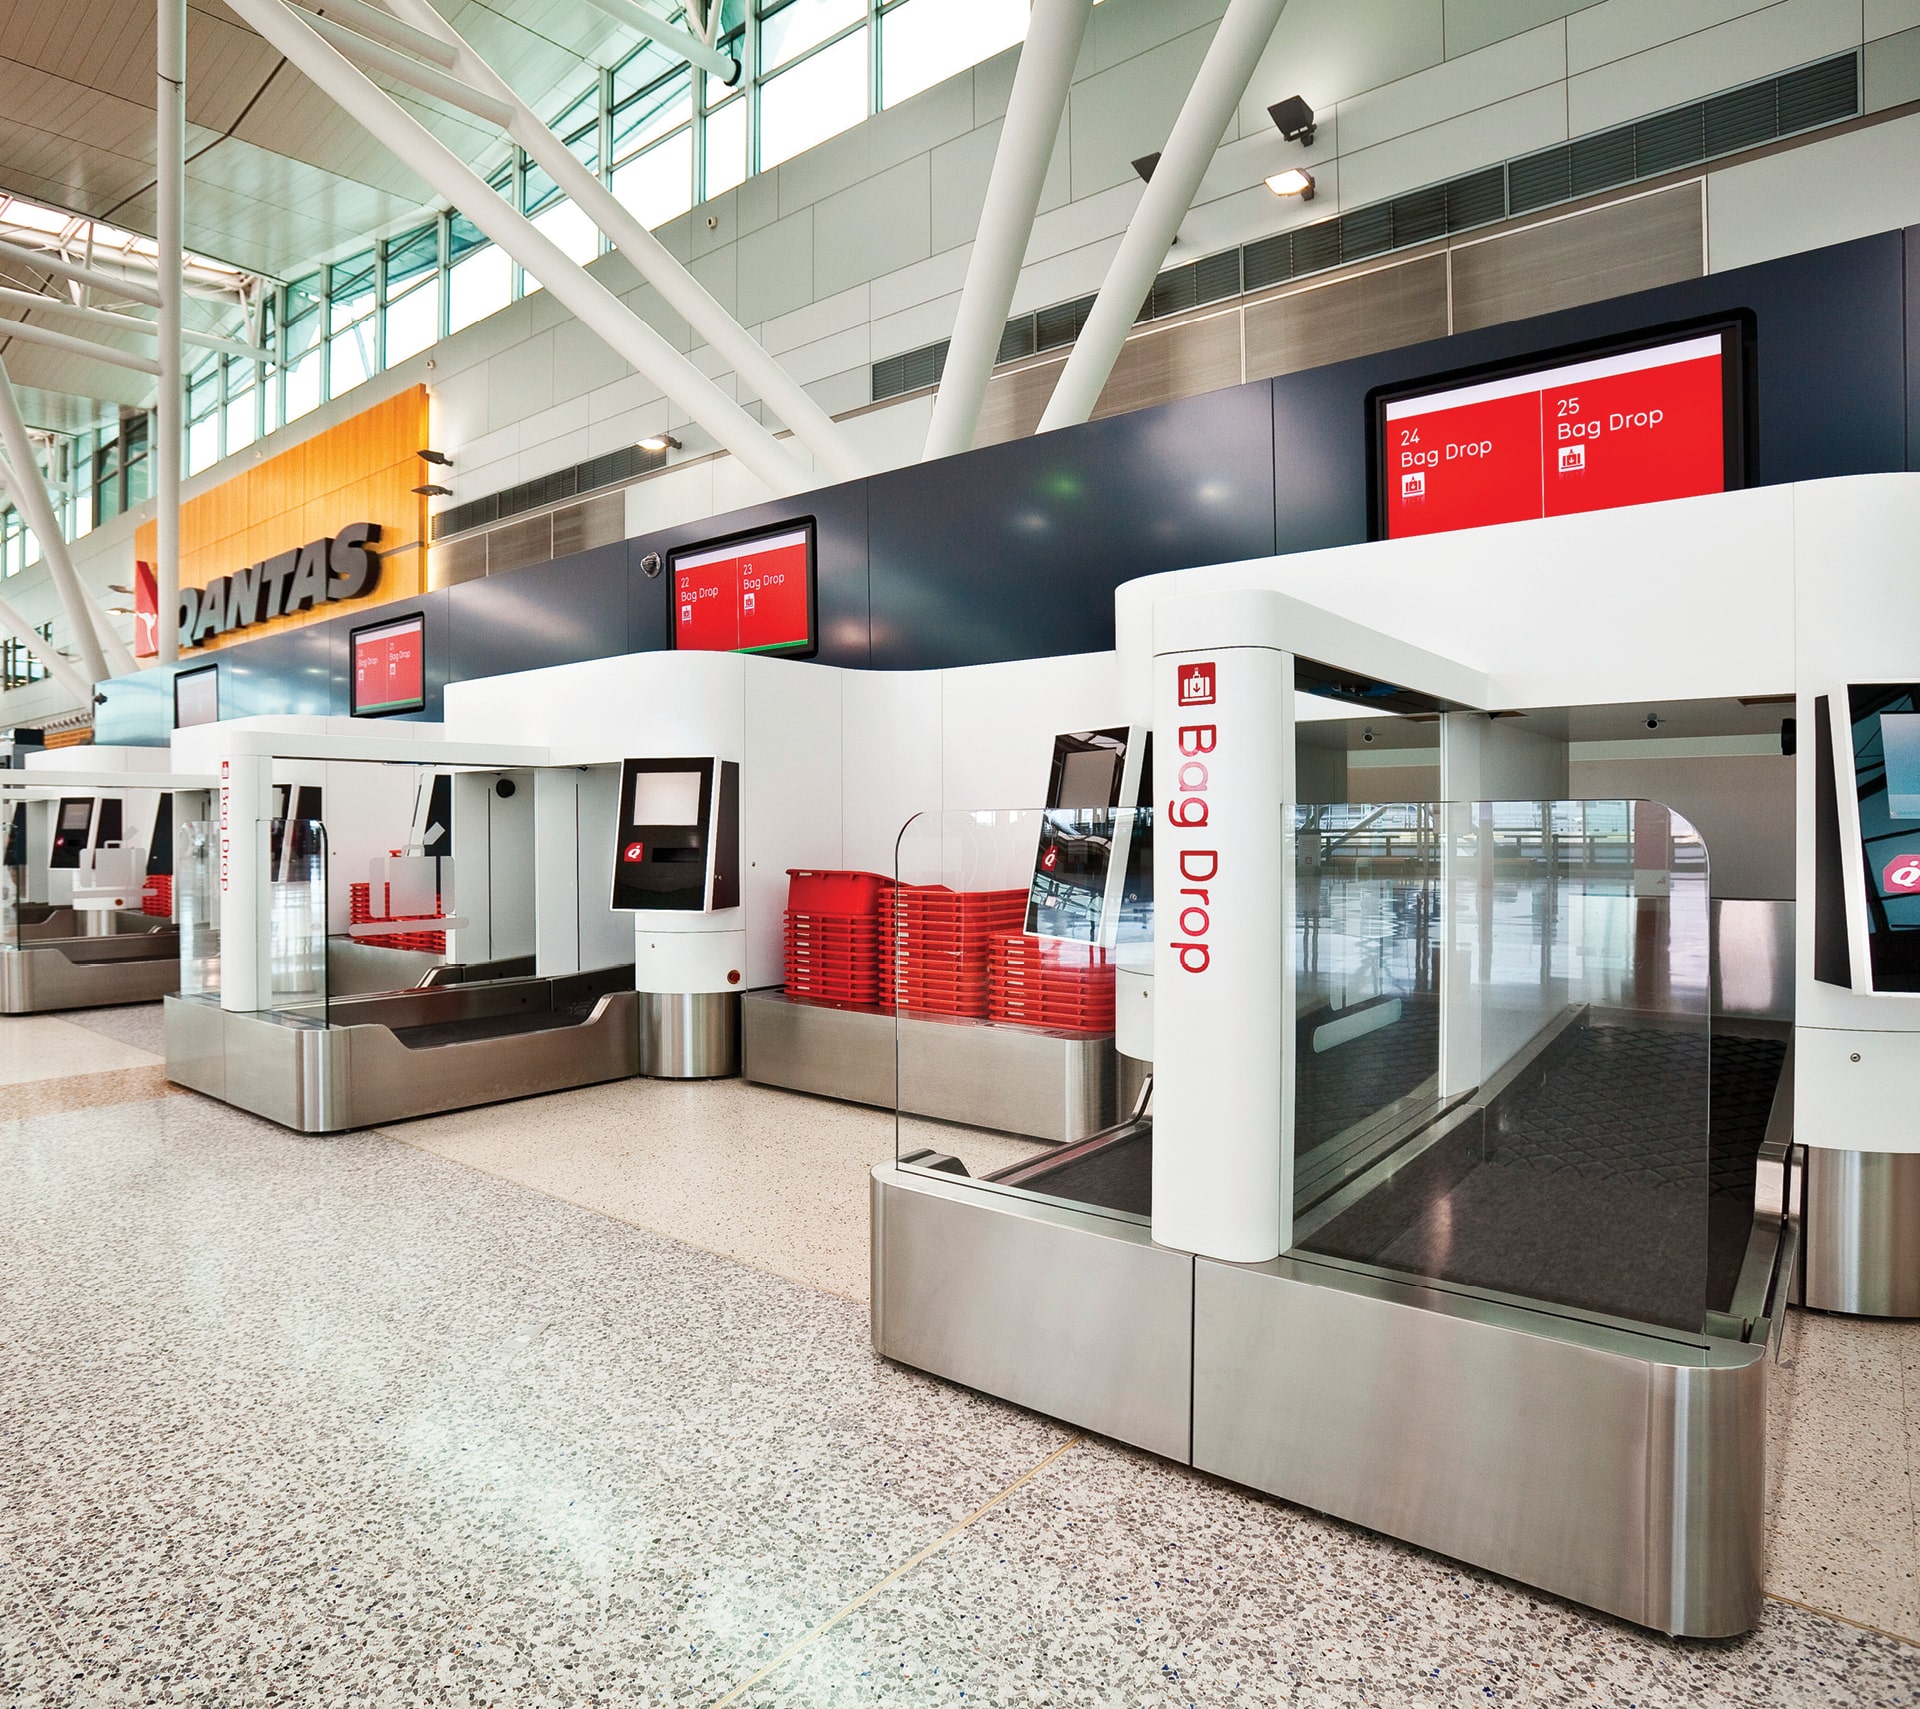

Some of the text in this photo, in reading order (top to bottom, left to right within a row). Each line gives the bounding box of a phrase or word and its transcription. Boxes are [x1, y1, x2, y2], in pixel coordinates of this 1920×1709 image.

[1557, 398, 1580, 417] 25
[1558, 408, 1664, 440] Bag Drop
[1401, 428, 1420, 446] 24
[1401, 438, 1492, 468] Bag Drop
[743, 563, 753, 575] 23
[178, 522, 382, 648] QANTAS
[681, 577, 690, 588] 22
[743, 573, 785, 591] Bag Drop
[681, 587, 718, 602] Bag Drop
[220, 786, 229, 891] Bag Drop
[1168, 724, 1218, 973] Bag Drop
